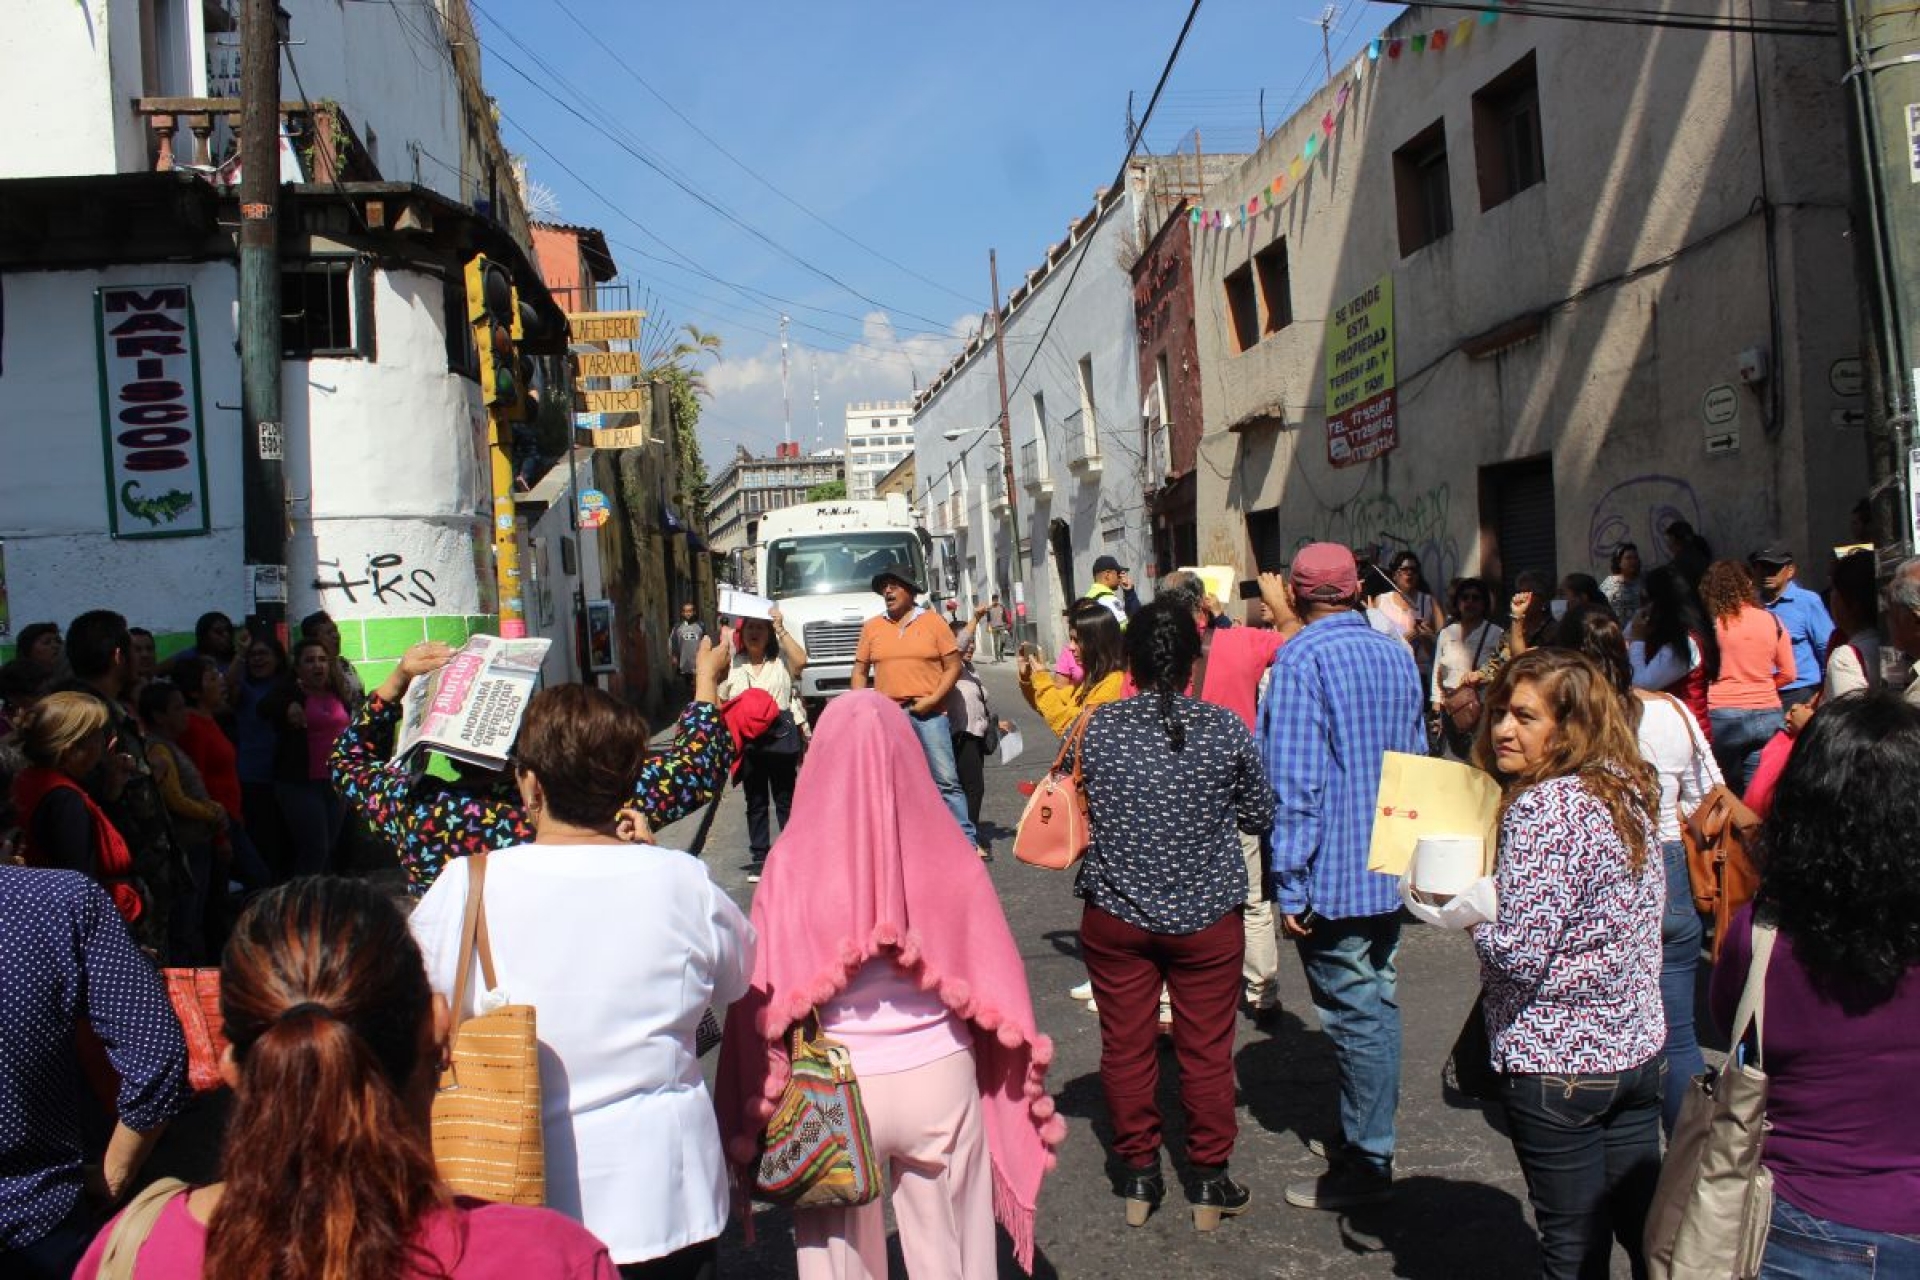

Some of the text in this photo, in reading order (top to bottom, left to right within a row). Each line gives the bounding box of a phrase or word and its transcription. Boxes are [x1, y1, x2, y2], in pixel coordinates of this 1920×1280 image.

[1335, 284, 1380, 326] SE VENDE
[1346, 314, 1370, 339] ESTA
[105, 288, 192, 472] MARISCOS
[581, 353, 639, 375] TARAXIA
[585, 391, 639, 412] ENTRO
[483, 683, 516, 746] ENFRENTAR
[499, 696, 522, 737] EL 2020
